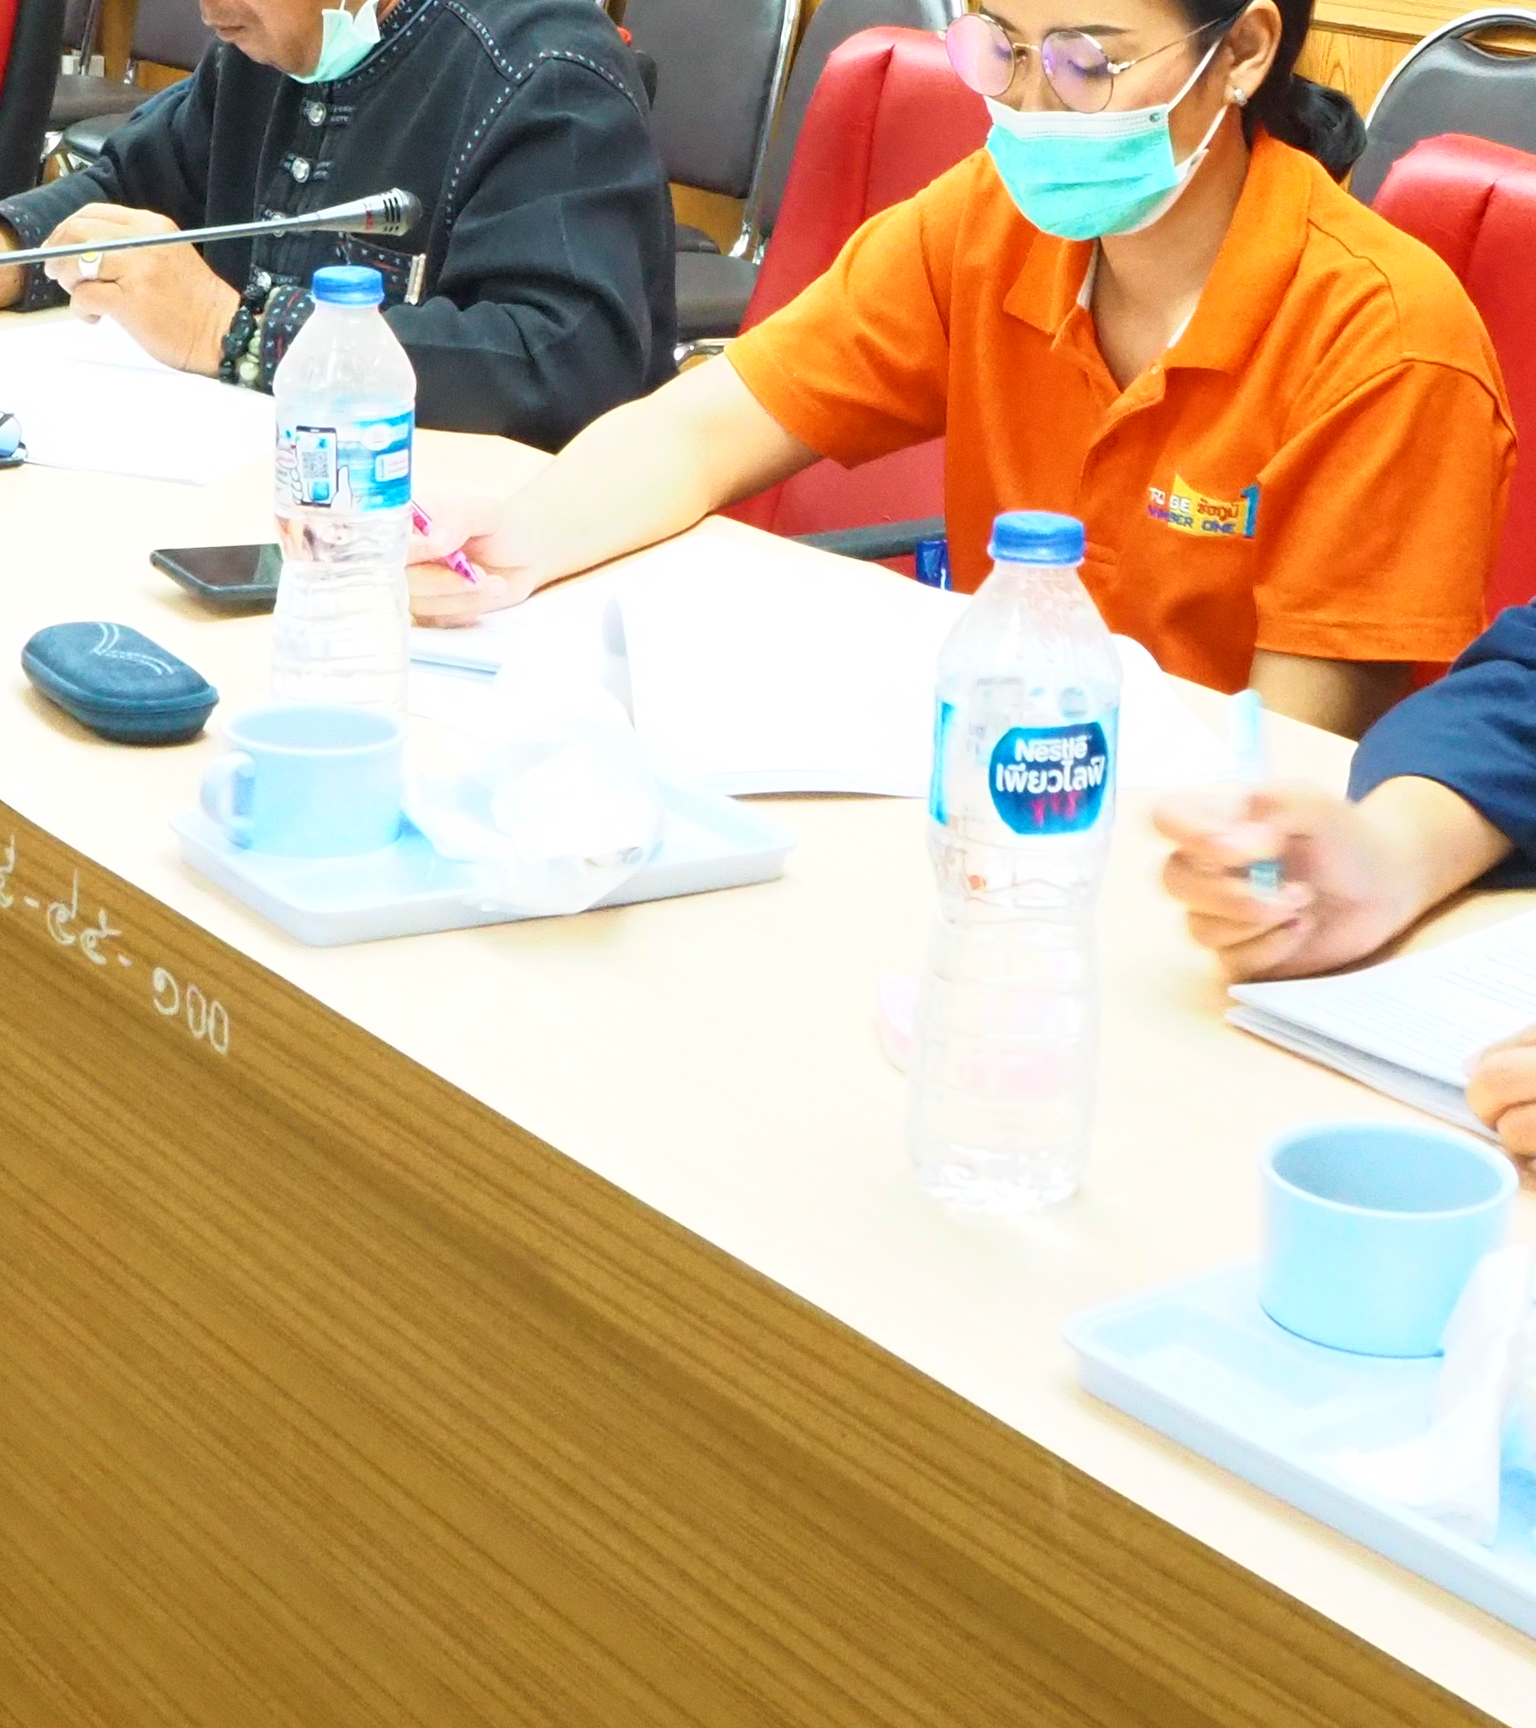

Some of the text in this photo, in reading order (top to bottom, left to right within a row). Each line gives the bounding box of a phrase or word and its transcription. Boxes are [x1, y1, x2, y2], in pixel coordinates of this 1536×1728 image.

[1148, 486, 1192, 515] TO BE
[1201, 519, 1237, 535] ONE
[1014, 735, 1089, 763] Nestlé
